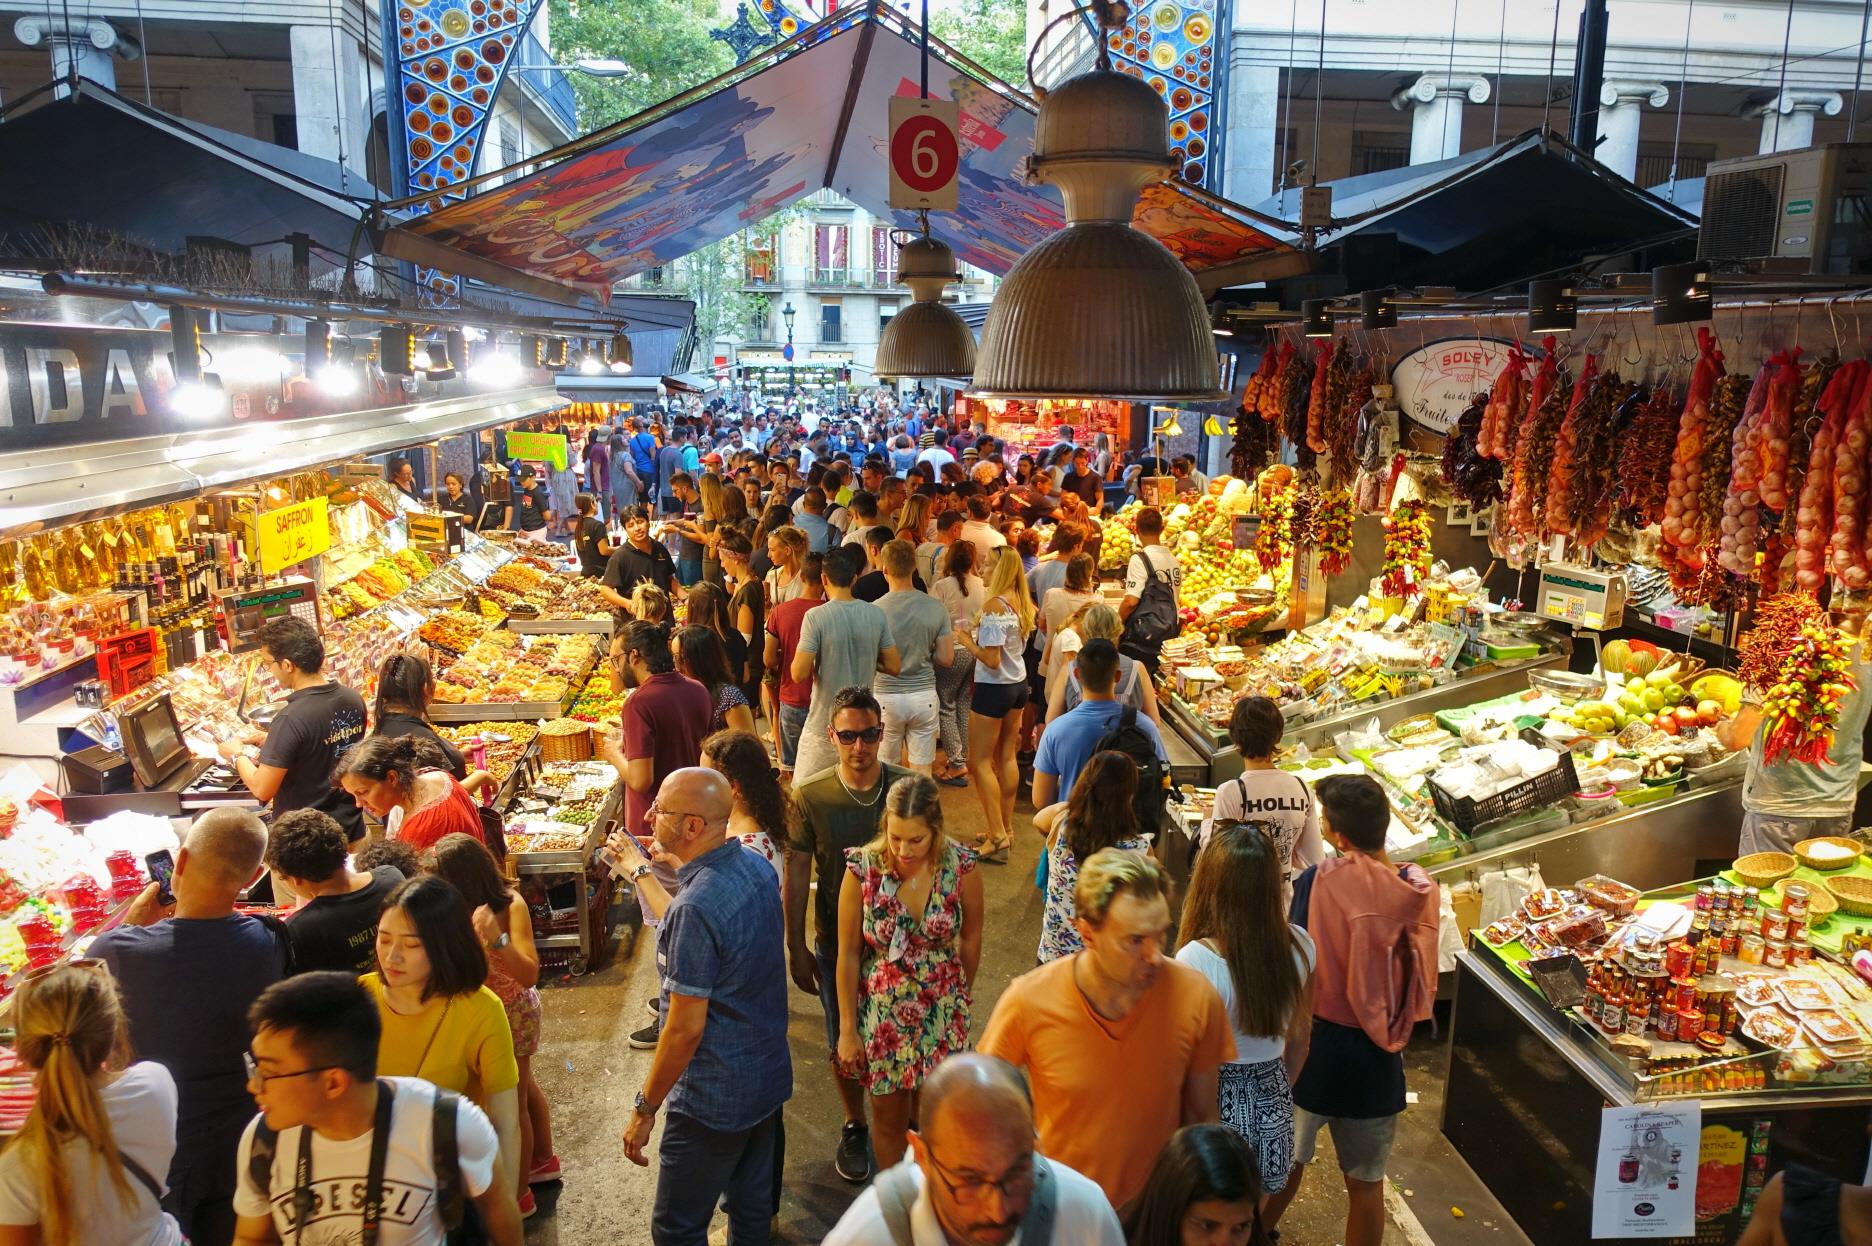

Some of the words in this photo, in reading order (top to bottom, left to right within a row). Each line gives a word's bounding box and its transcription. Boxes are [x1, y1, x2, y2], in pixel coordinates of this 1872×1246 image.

[912, 130, 939, 178] 6
[1442, 352, 1494, 367] SOLEY
[276, 506, 313, 534] SAFFRON
[1504, 782, 1534, 801] PILLIN
[348, 929, 369, 948] 1987
[1700, 1142, 1736, 1152] ARTINEZ
